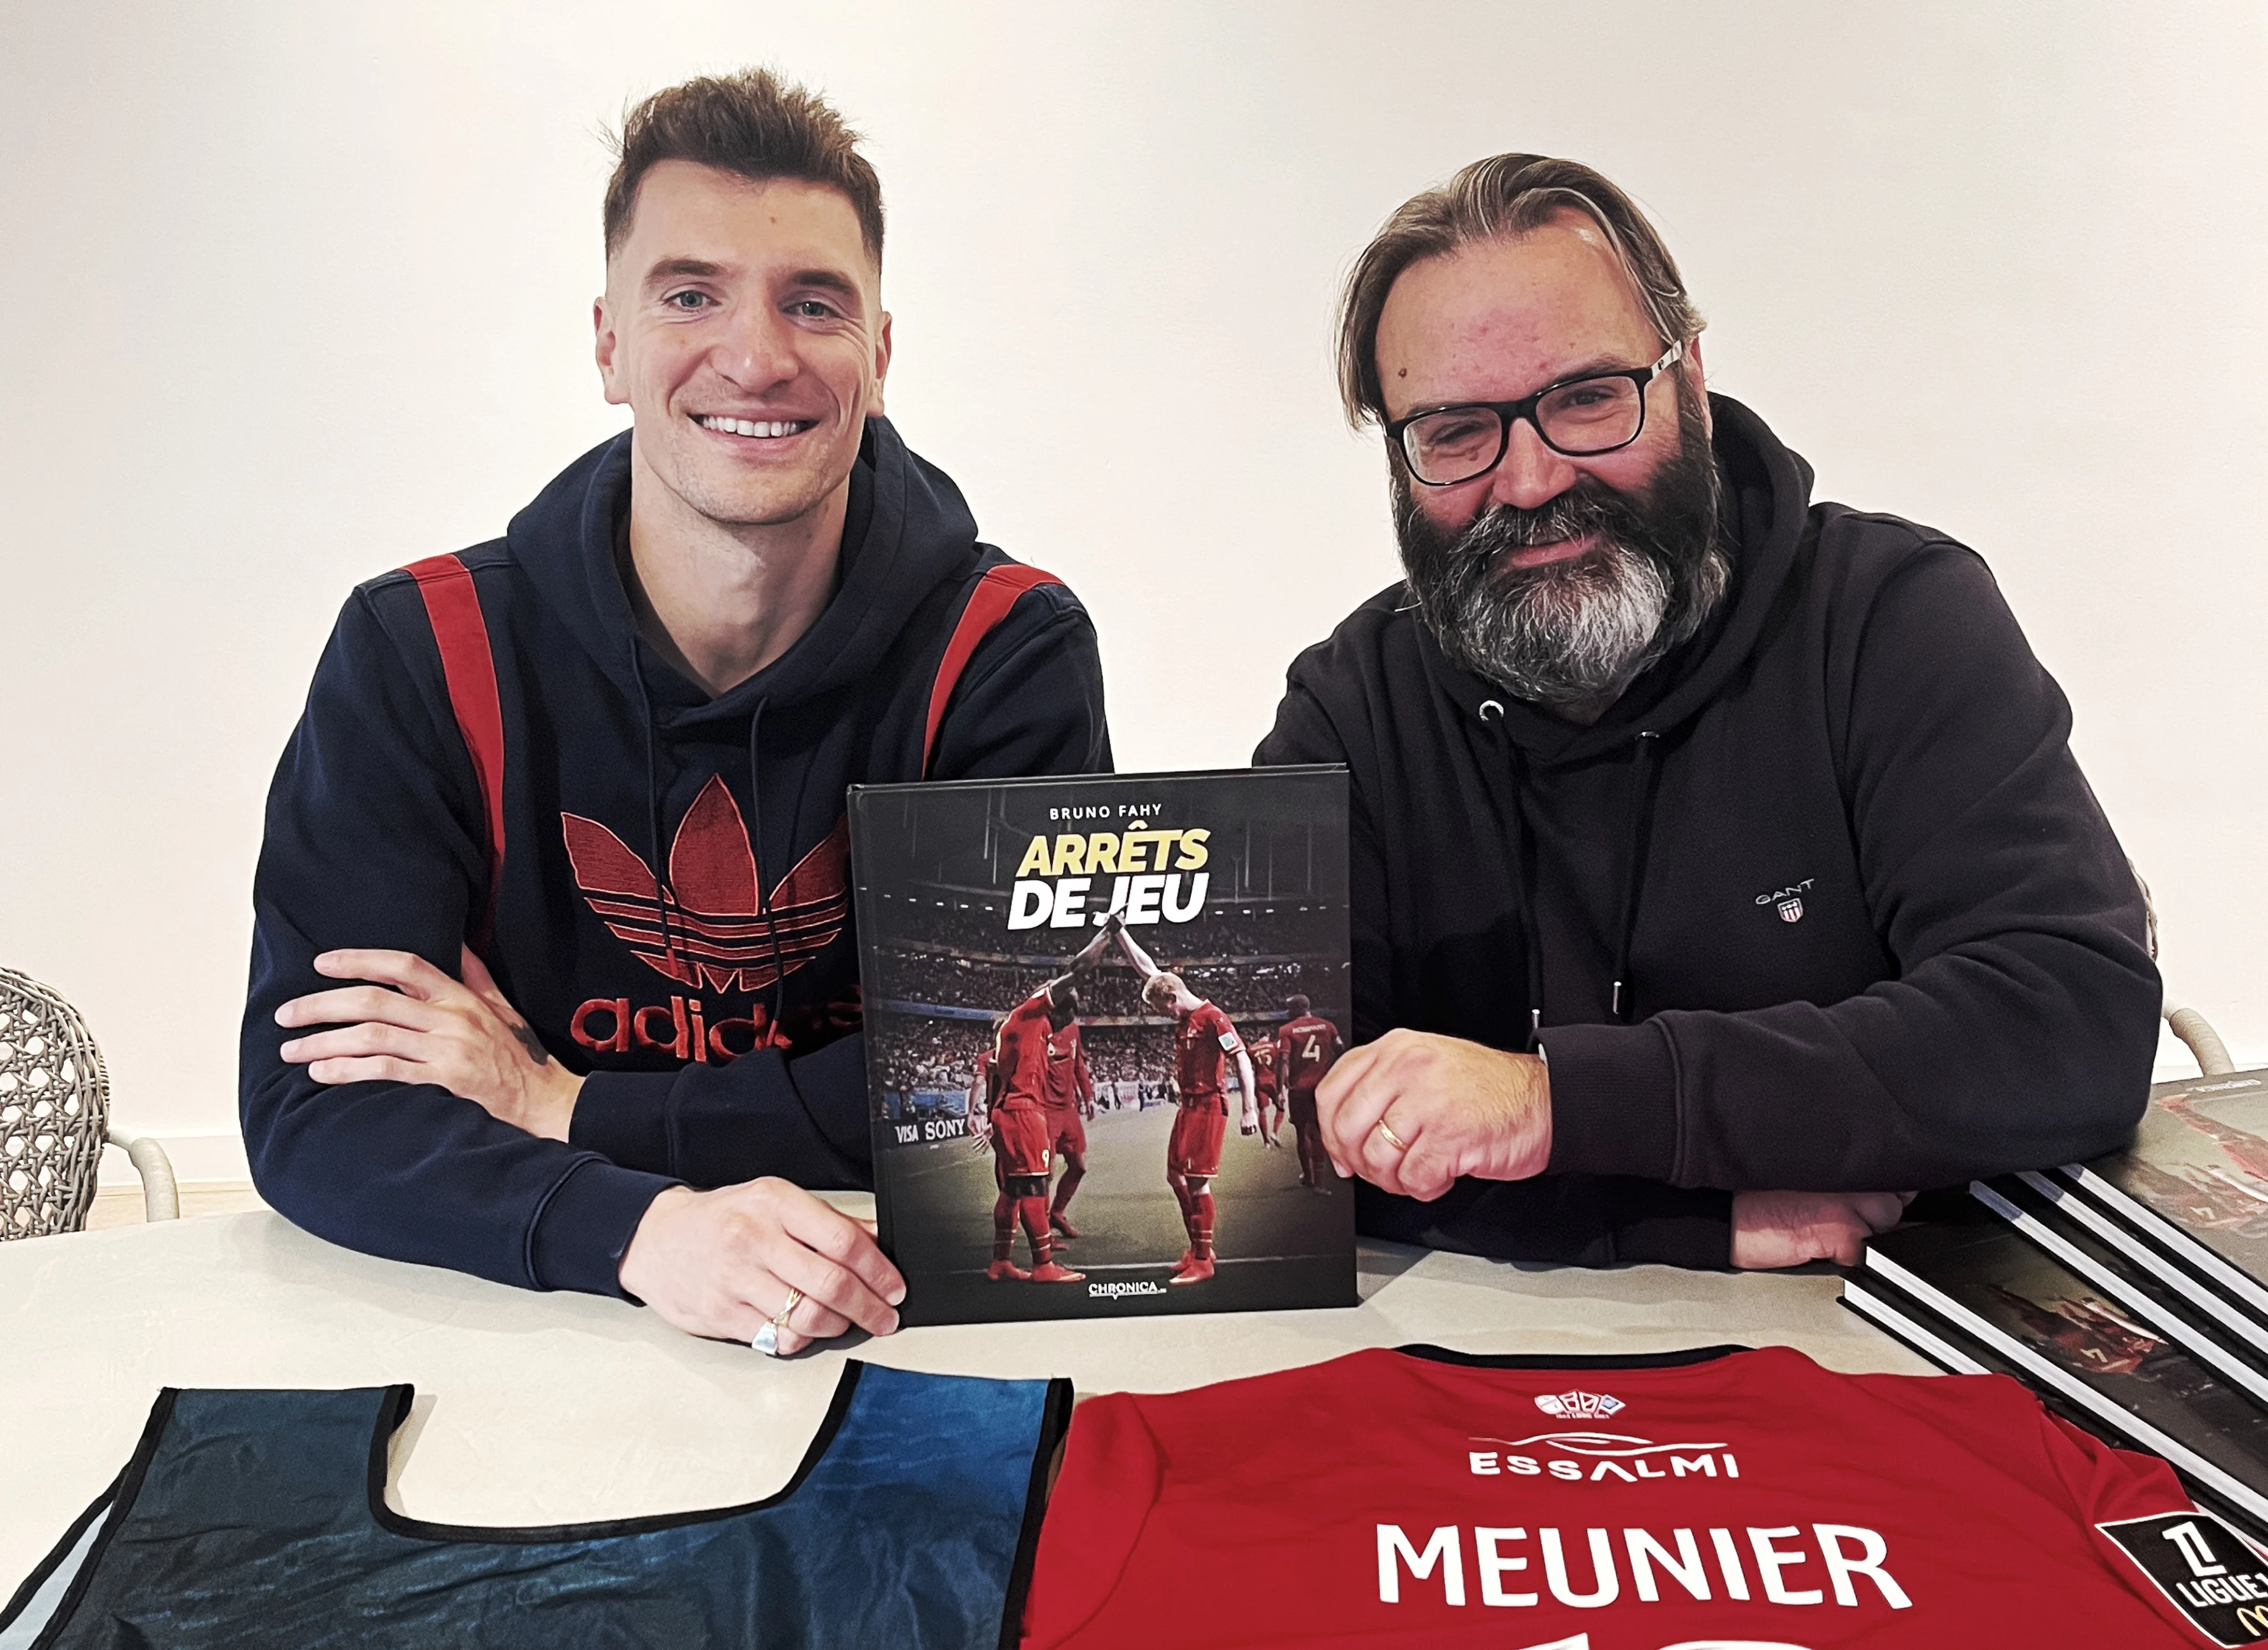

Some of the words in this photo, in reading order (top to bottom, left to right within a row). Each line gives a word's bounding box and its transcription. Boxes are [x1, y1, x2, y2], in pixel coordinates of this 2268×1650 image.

[1050, 805, 1110, 821] BRUNO
[1119, 803, 1162, 818] FAHY
[1016, 820, 1211, 877] ARRÊTS
[1007, 877, 1091, 930] DE
[1093, 873, 1210, 928] JEU
[1755, 878, 1815, 905] GANT
[1302, 1034, 1320, 1062] 4
[894, 1124, 919, 1144] VISA
[925, 1118, 966, 1141] SONY
[1041, 1149, 1050, 1168] 9
[1376, 1524, 1914, 1610] MEUNIER
